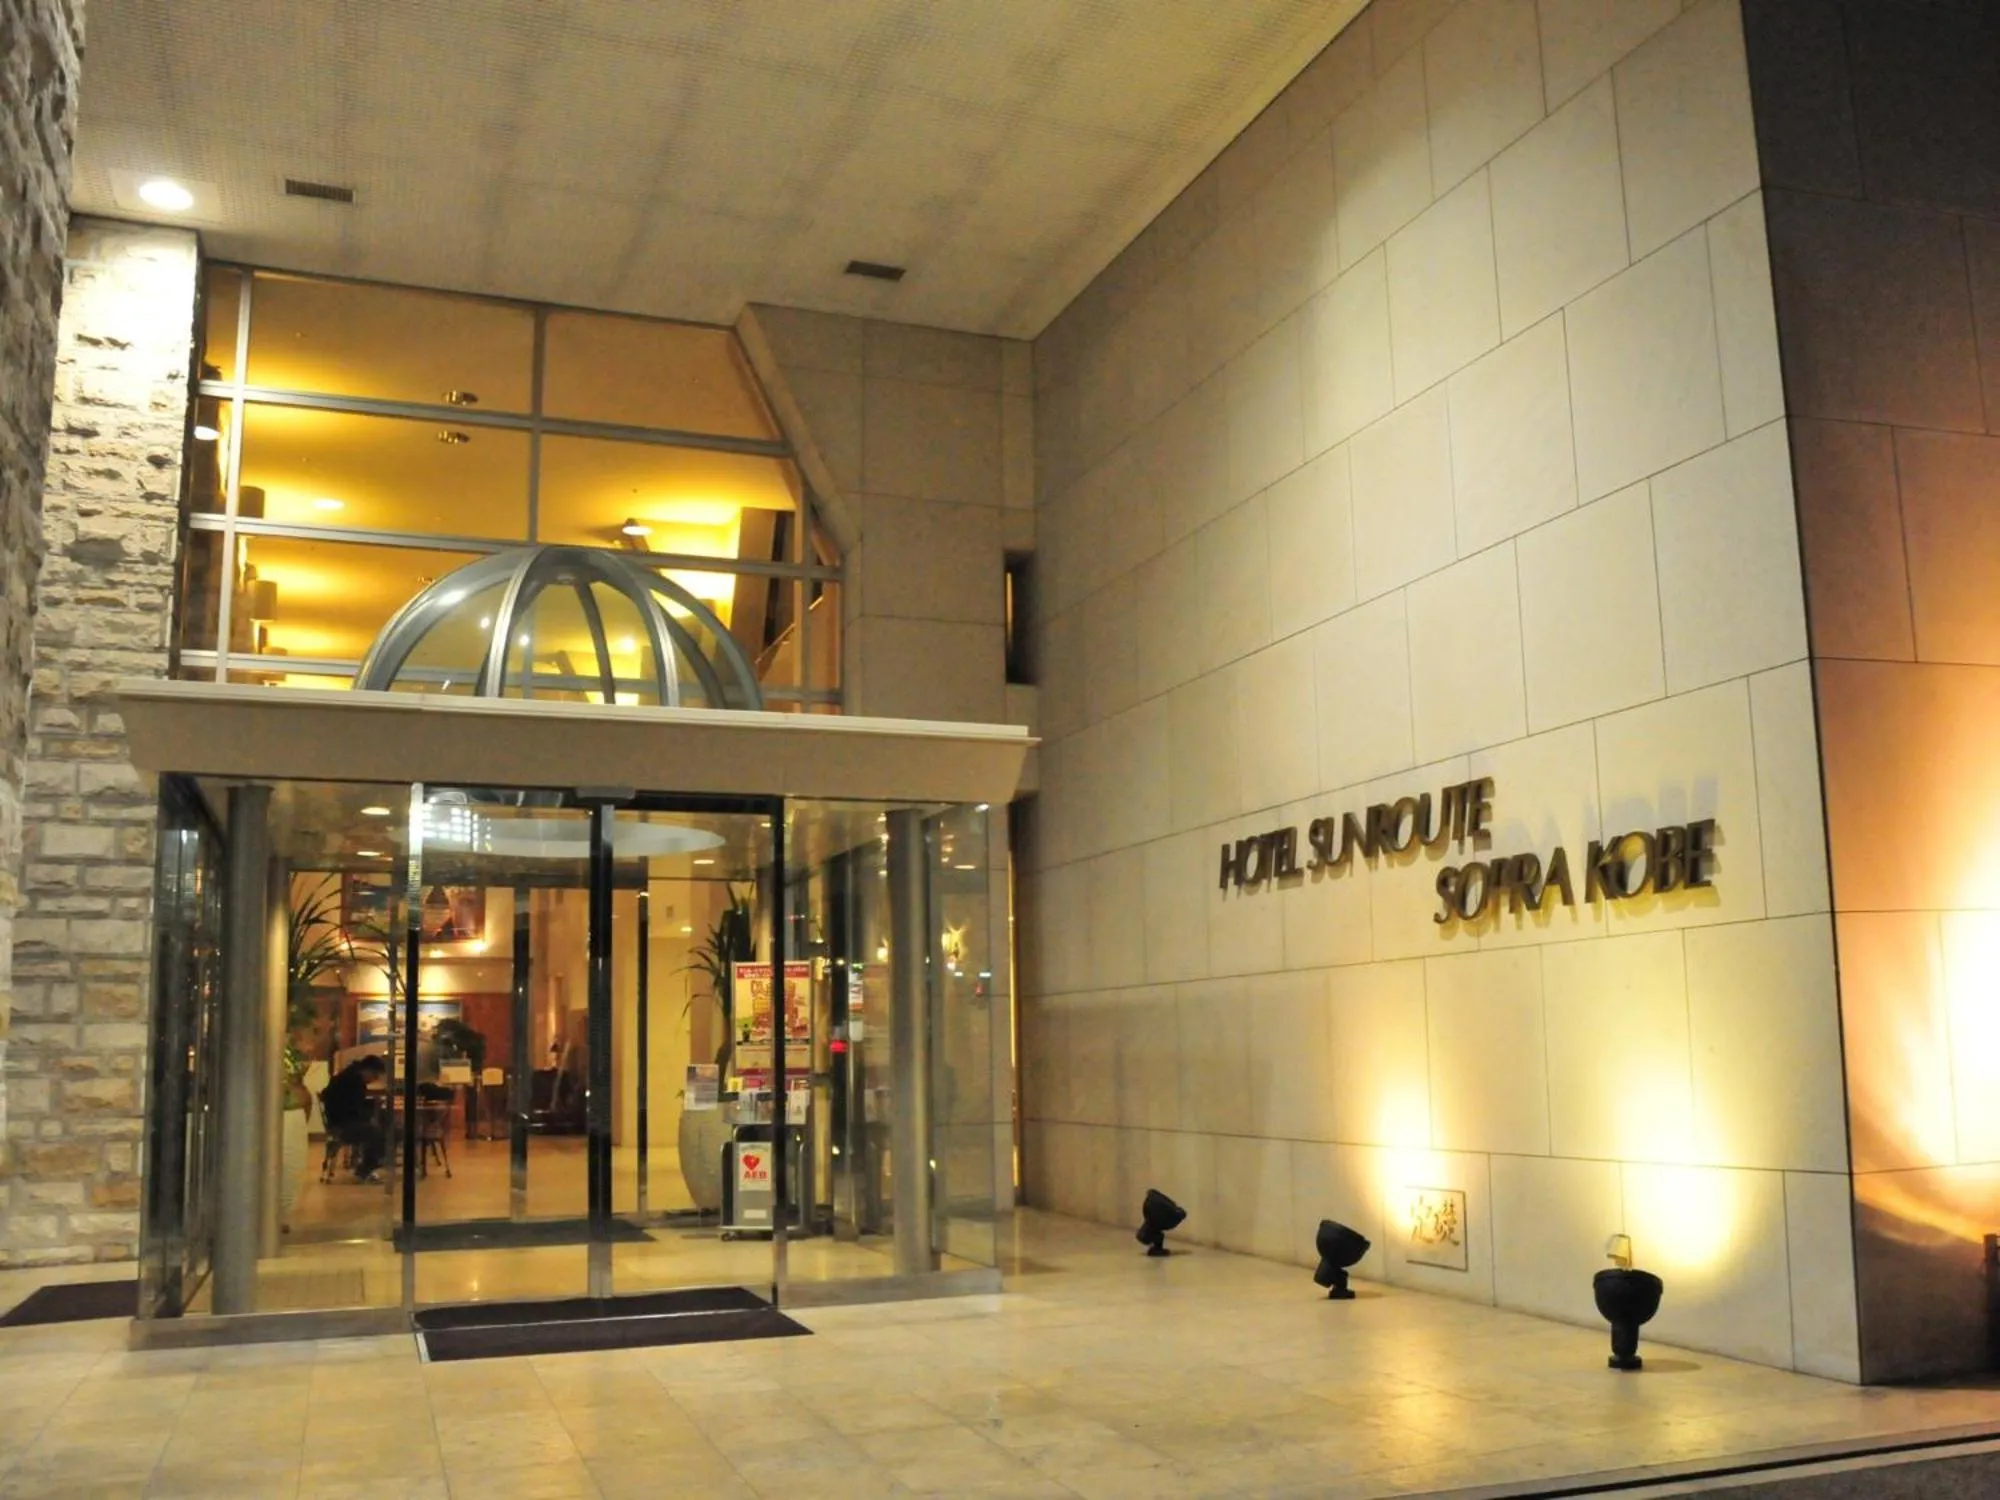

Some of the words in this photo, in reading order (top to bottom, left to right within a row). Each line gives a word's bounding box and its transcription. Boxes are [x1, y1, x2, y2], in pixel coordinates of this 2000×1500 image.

[1219, 826, 1303, 889] HOTEL
[1307, 777, 1494, 870] SUNROUTE
[1434, 847, 1574, 925] SOPRA
[1585, 819, 1716, 904] KOBE
